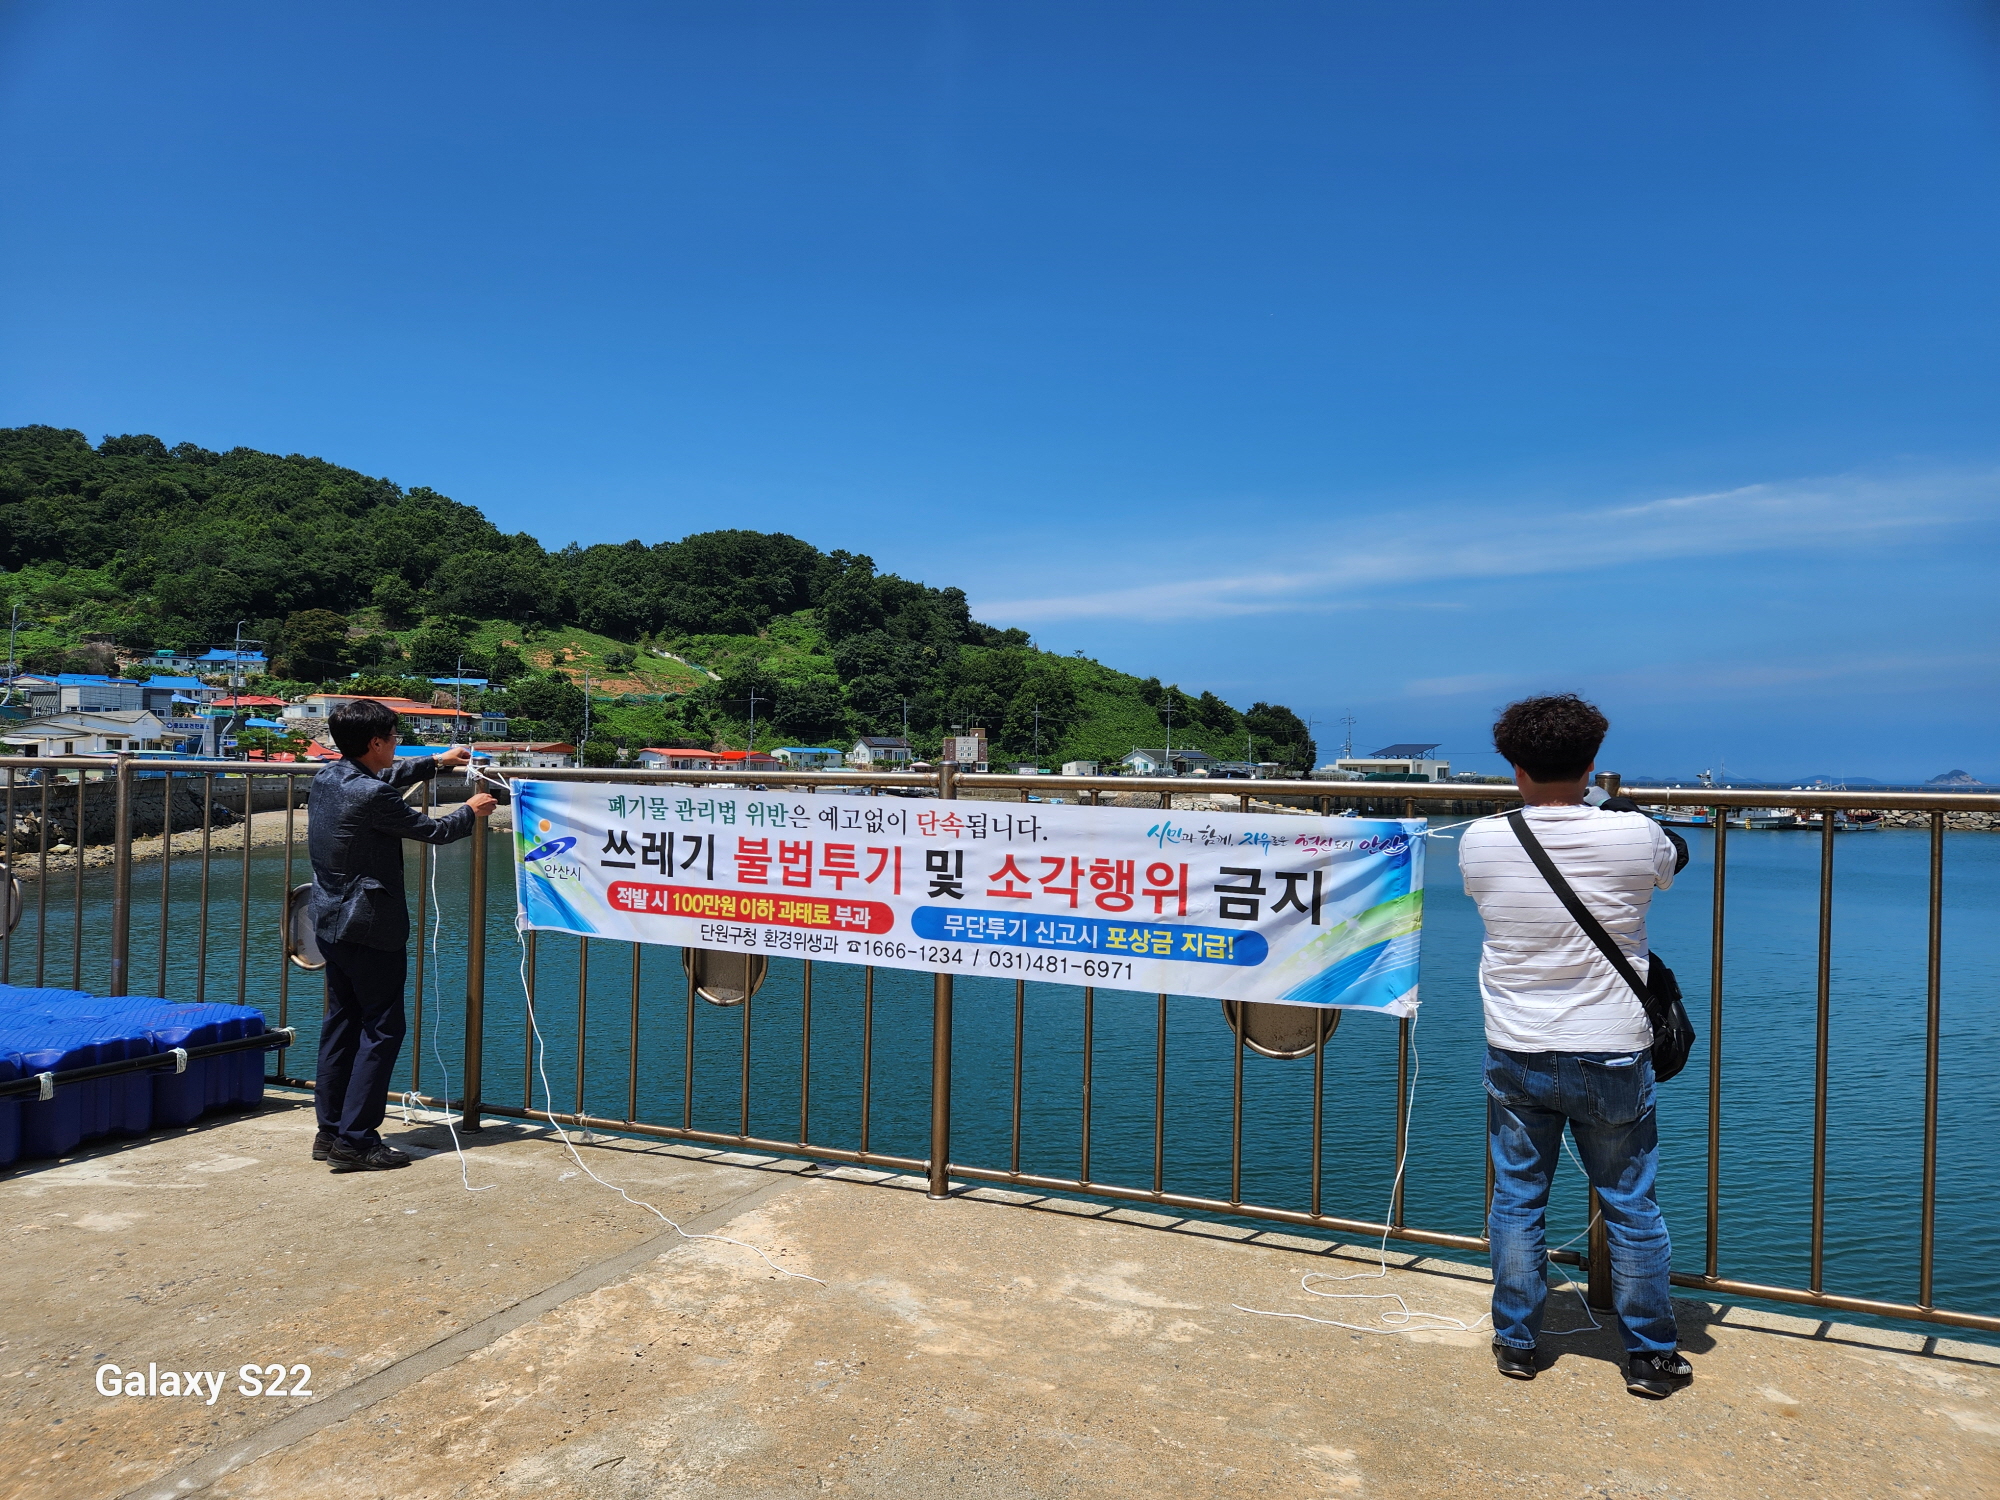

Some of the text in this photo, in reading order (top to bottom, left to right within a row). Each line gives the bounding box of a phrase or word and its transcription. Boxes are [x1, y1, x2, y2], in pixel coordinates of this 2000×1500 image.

[608, 795, 1048, 843] 폐기물 관리법 위반은 예고없이 단속됩니다.
[1147, 820, 1197, 849] 시민과
[1238, 831, 1290, 856] 자유로운
[1294, 834, 1353, 858] 혁신도시
[1359, 835, 1409, 856] 안산
[544, 864, 581, 882] 안산시
[600, 829, 1323, 926] 쓰레기 불법투기 및 소각행위 금지
[616, 887, 871, 929] 적발 시 100만원 이하 과태료 부과
[700, 923, 757, 948] 단원구청
[763, 929, 839, 954] 환경위생과
[864, 938, 963, 965] 1666-1234
[989, 949, 1133, 981] 031)481-6971
[943, 914, 1235, 960] 무단투기 신고시 포상금 지급!
